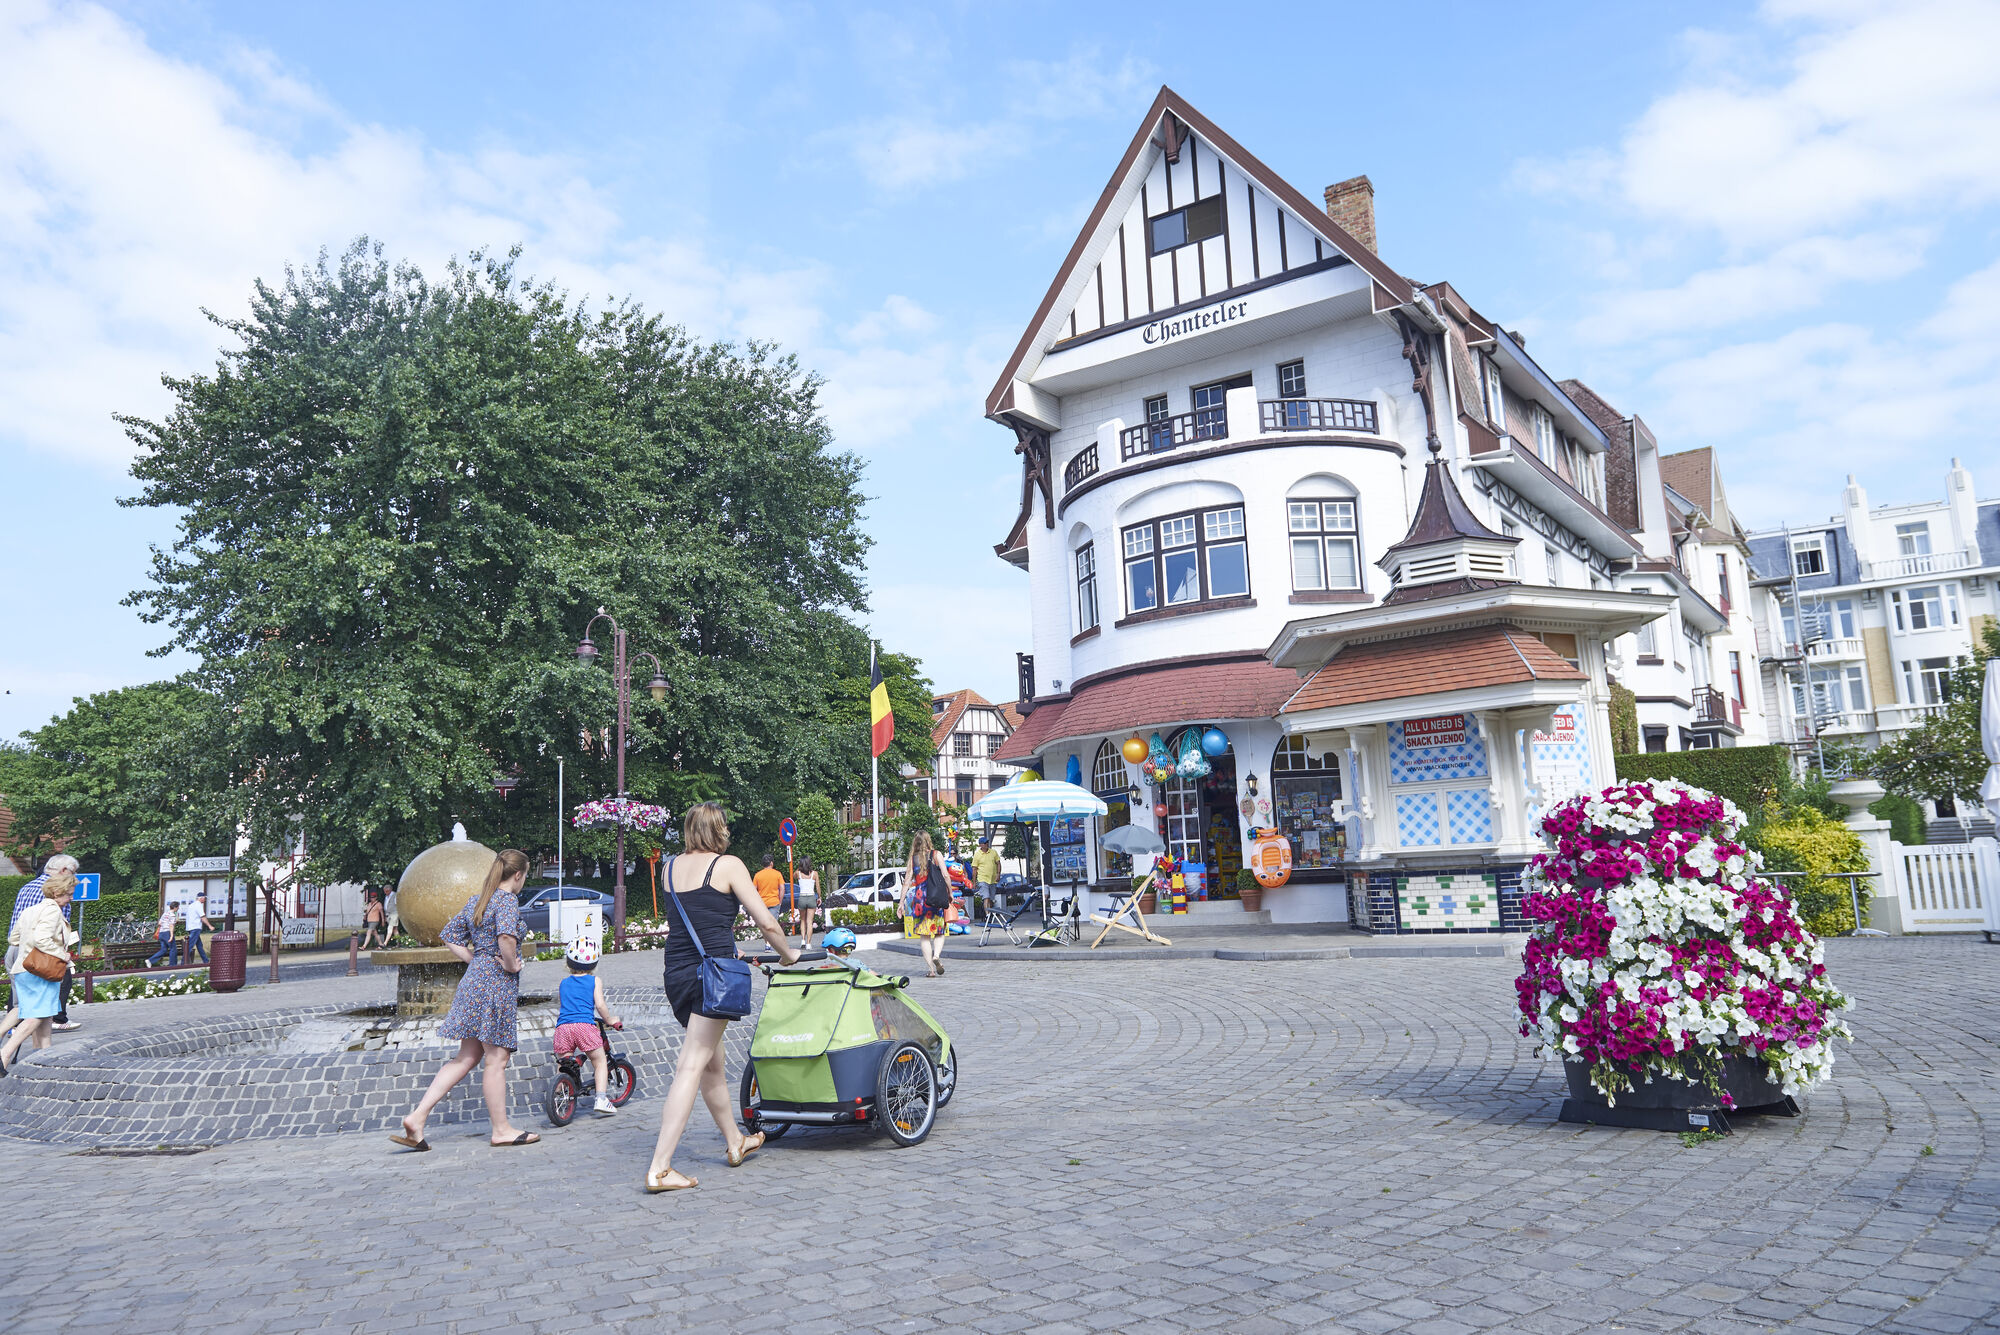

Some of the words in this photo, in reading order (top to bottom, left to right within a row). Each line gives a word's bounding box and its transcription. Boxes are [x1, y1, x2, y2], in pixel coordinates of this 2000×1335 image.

[1142, 301, 1248, 344] Chantecler
[1405, 722, 1420, 734] ALL
[1422, 721, 1428, 731] U
[1430, 719, 1452, 730] NEED
[1454, 718, 1463, 728] IS
[1566, 717, 1574, 727] IS
[1406, 735, 1432, 748] SNACK
[1433, 732, 1464, 745] DJENDO
[1552, 732, 1575, 742] DJENDO
[1931, 844, 1975, 854] HOTEL
[281, 923, 315, 940] Gallica
